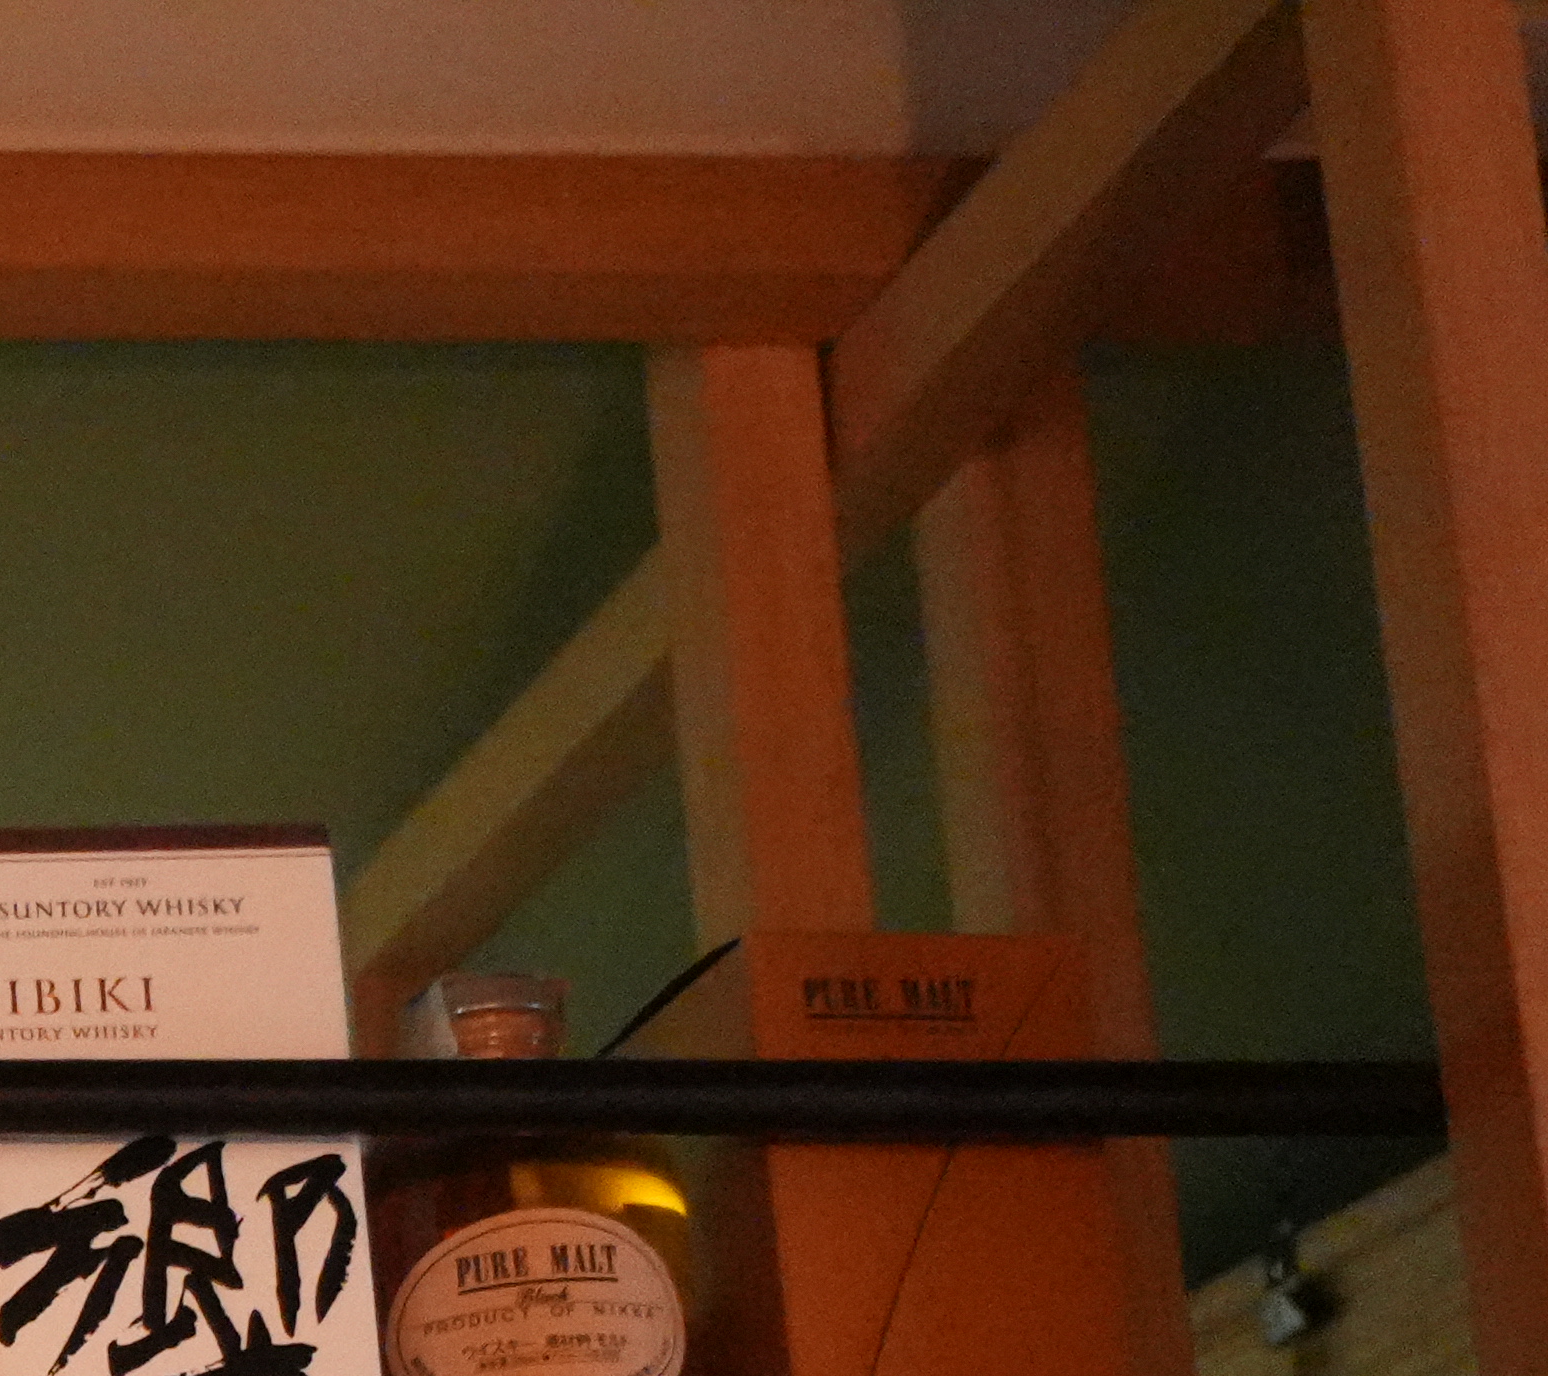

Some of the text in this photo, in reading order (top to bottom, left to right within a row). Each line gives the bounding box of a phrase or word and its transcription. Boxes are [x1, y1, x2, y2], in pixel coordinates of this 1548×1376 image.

[136, 897, 246, 917] WHISKY
[803, 976, 975, 1012] PURE MALT
[72, 1023, 157, 1041] WHISKY
[456, 1243, 618, 1288] PURE MALT
[423, 1302, 574, 1336] PRODUCT OF
